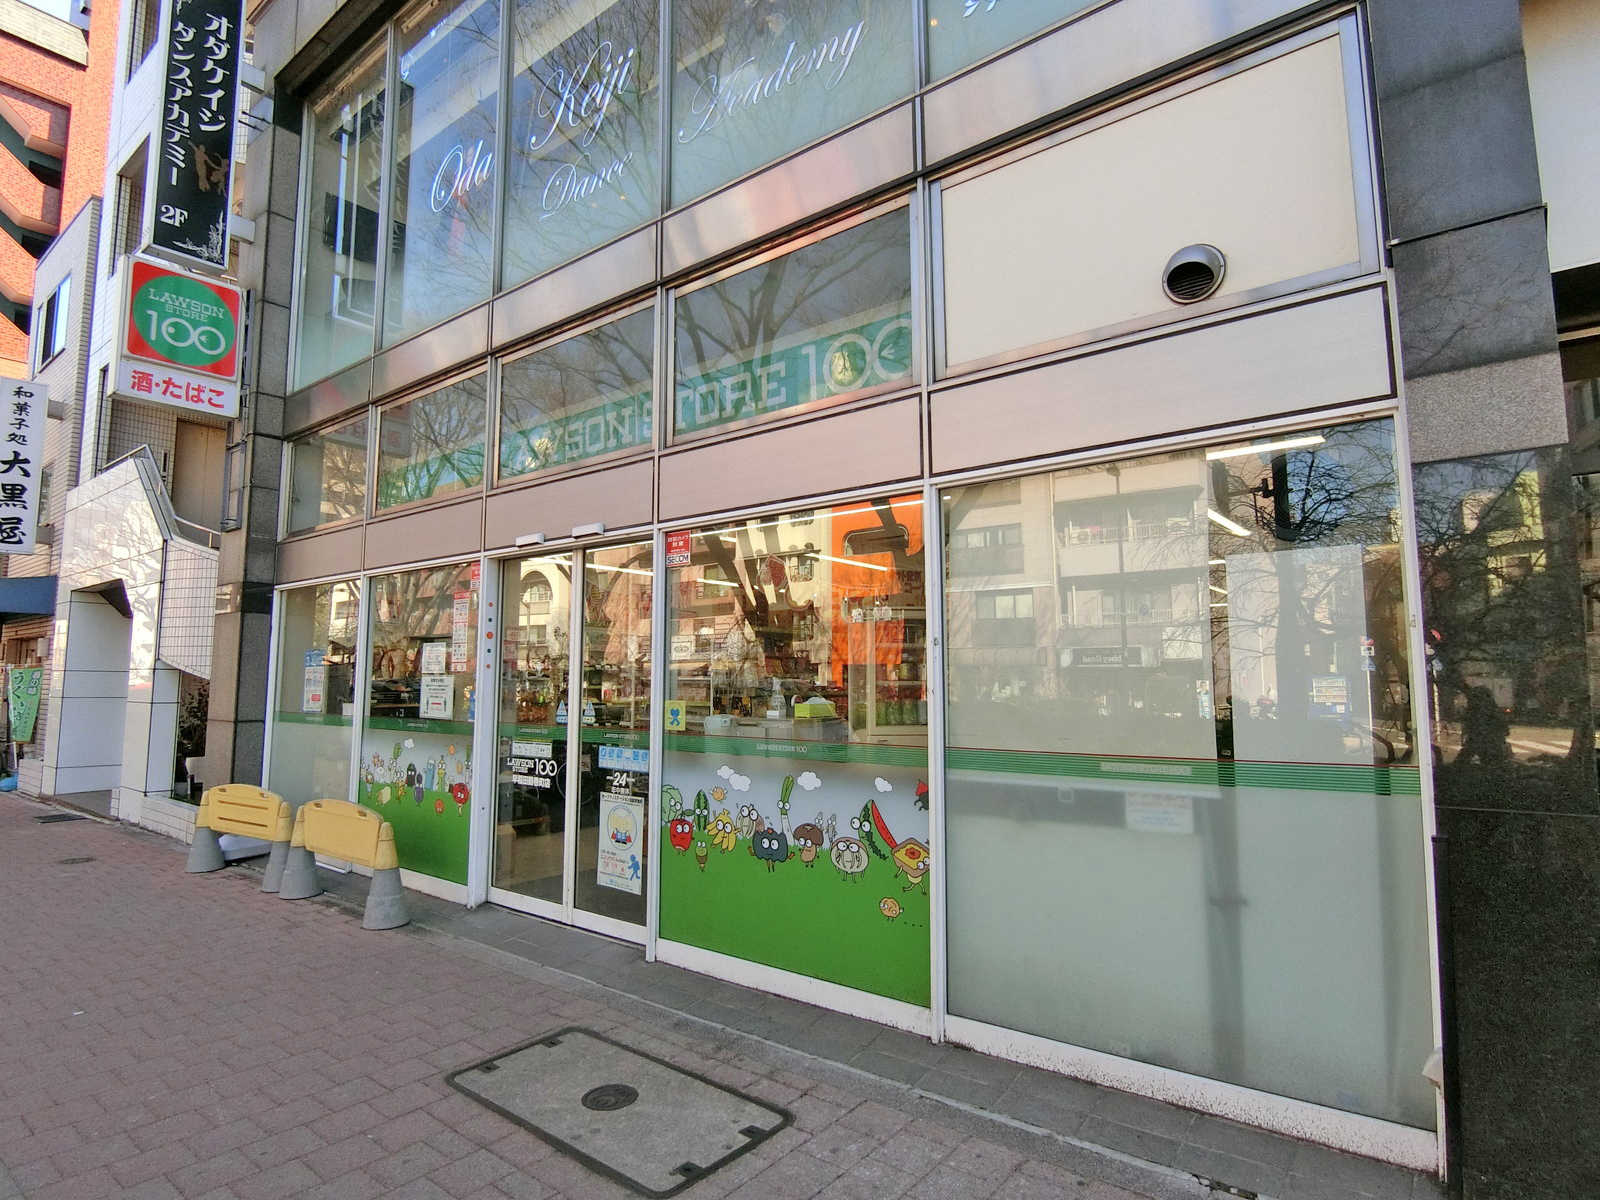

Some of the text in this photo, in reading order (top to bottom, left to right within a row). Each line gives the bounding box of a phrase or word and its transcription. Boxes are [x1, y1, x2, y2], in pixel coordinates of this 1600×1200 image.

[199, 12, 234, 132] オダケイジ
[164, 20, 197, 186] ダンスアカデミー
[539, 21, 869, 222] Dance Academy
[431, 41, 635, 212] Oda Keiji
[160, 204, 188, 228] 2F
[149, 288, 224, 319] LAWSON
[166, 304, 208, 323] STORE
[146, 310, 226, 355] 100
[131, 369, 225, 409] 酒・たばこ
[5, 386, 34, 446] 和菓子処
[0, 450, 31, 545] 大黒屋
[667, 554, 689, 564] SECOM
[506, 757, 558, 777] LAWSON 100
[612, 772, 628, 787] 24
